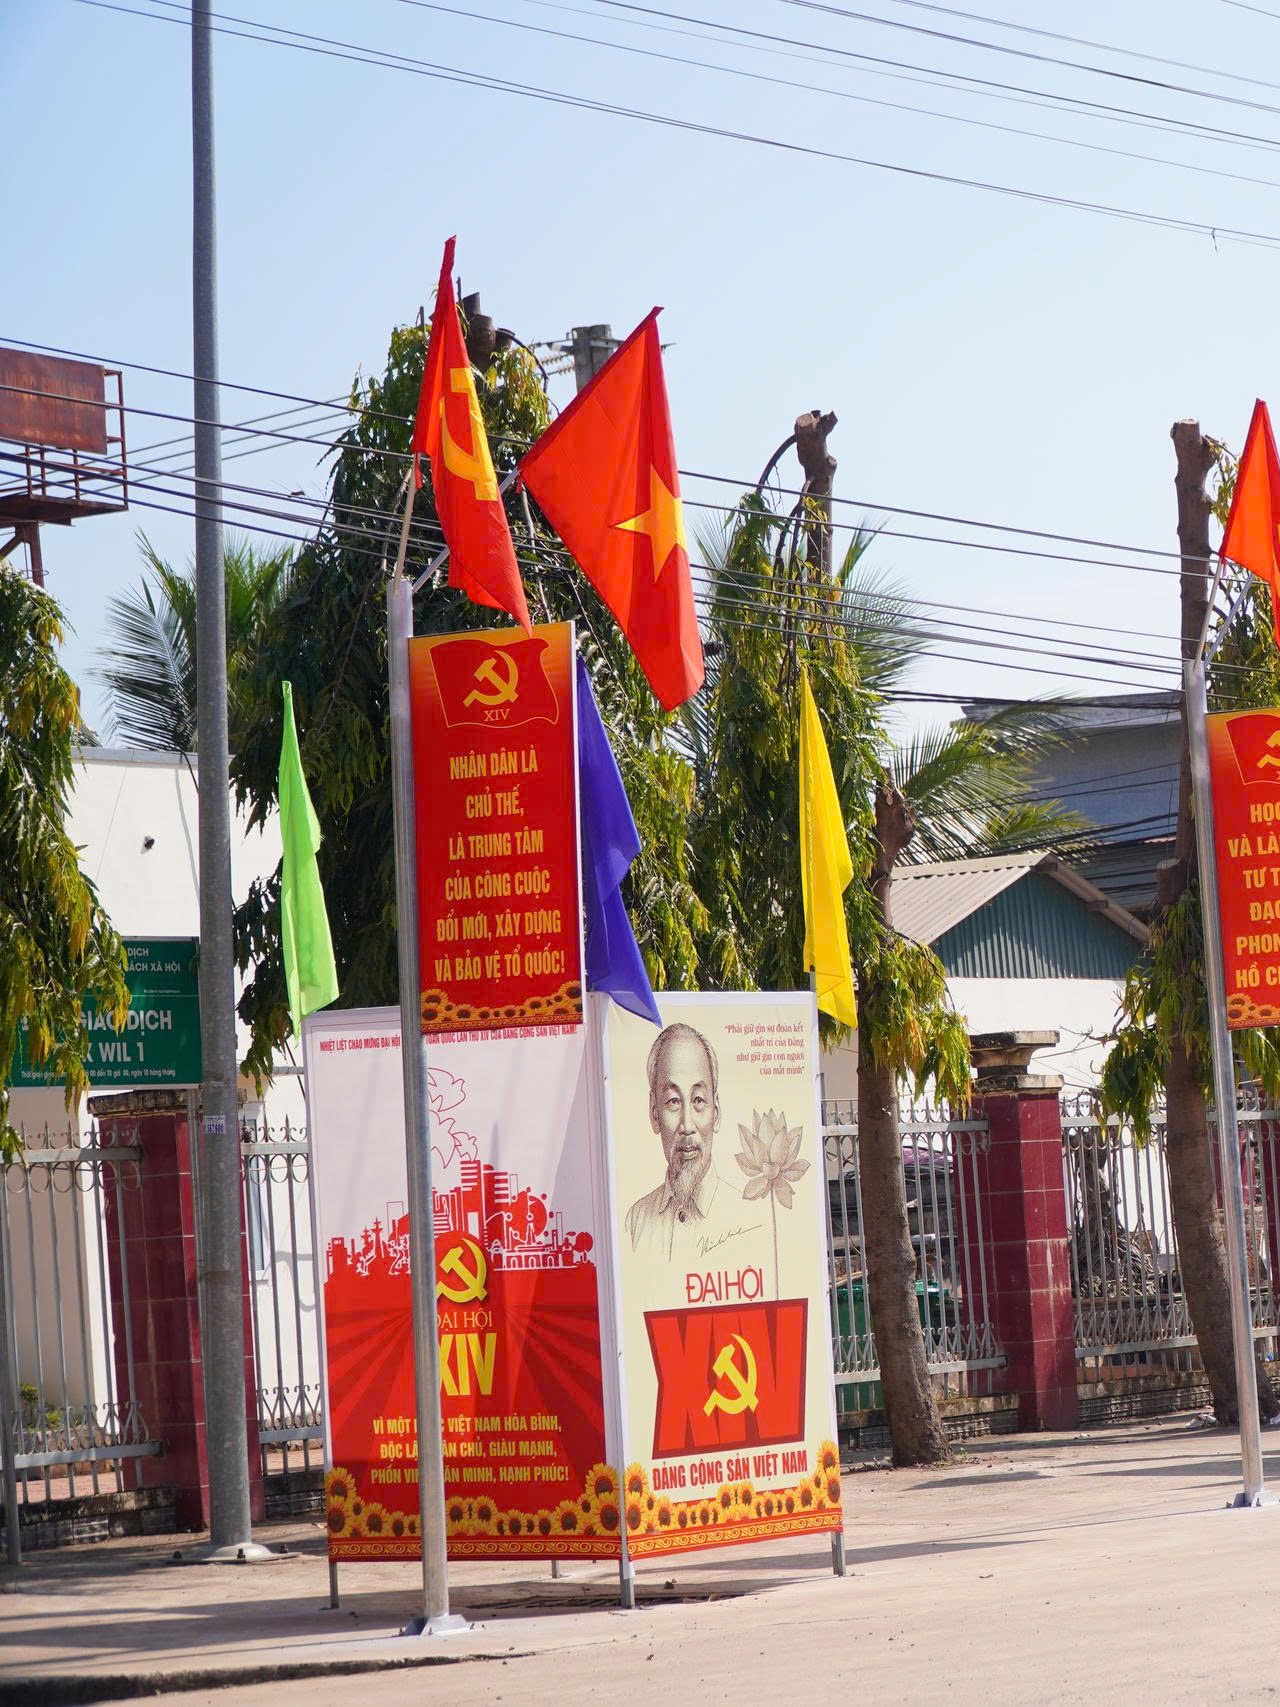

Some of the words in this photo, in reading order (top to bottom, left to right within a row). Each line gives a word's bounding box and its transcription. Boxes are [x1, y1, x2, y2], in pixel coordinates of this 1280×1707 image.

[484, 709, 510, 722] XIV
[449, 753, 486, 780] NHÂN
[490, 748, 517, 776] DÂN
[521, 744, 538, 773] LÀ
[466, 789, 491, 818] CHỦ
[449, 833, 465, 861] LÀ
[469, 832, 512, 858] TRUNG
[516, 827, 543, 854] TÂM
[1229, 832, 1252, 857] VÀ
[445, 869, 472, 900] CỦA
[475, 875, 511, 898] CÔNG
[515, 867, 550, 896] CUỘC
[1243, 867, 1266, 889] TƯ
[437, 910, 459, 943] ĐỔI
[463, 910, 492, 941] MỚI,
[496, 910, 520, 938] XÂY
[525, 909, 561, 937] DỰNG
[128, 948, 149, 958] DỊCH
[435, 953, 452, 982] VÀ
[455, 944, 481, 980] BẢO
[485, 951, 501, 983] VỆ
[504, 943, 520, 976] TỔ
[524, 943, 564, 975] QUỐC!
[151, 962, 162, 972] XÃ
[165, 962, 180, 974] HỘI
[1236, 963, 1260, 988] HỒ
[127, 1010, 172, 1036] DỊCH
[100, 1042, 131, 1062] WIL
[137, 1042, 144, 1061] 1
[686, 1272, 722, 1303] ĐẠI
[725, 1265, 763, 1301] HỘI
[464, 1307, 492, 1331] HỘI
[373, 1416, 384, 1434] VÌ
[387, 1416, 410, 1437] MỘT
[448, 1415, 470, 1436] VIỆT
[474, 1417, 500, 1432] NAM
[504, 1413, 527, 1432] HÒA
[530, 1412, 561, 1432] BÌNH,
[460, 1436, 486, 1458] CHỦ,
[489, 1438, 515, 1457] GIÀU
[519, 1440, 557, 1459] MẠNH,
[463, 1466, 496, 1483] MINH,
[500, 1466, 530, 1485] HẠNH
[534, 1463, 568, 1481] PHÚC!
[653, 1461, 686, 1491] ĐẢNG
[690, 1458, 723, 1490] CỘNG
[727, 1452, 750, 1482] SẢN
[753, 1450, 778, 1480] VIỆT
[782, 1450, 807, 1474] NAM
